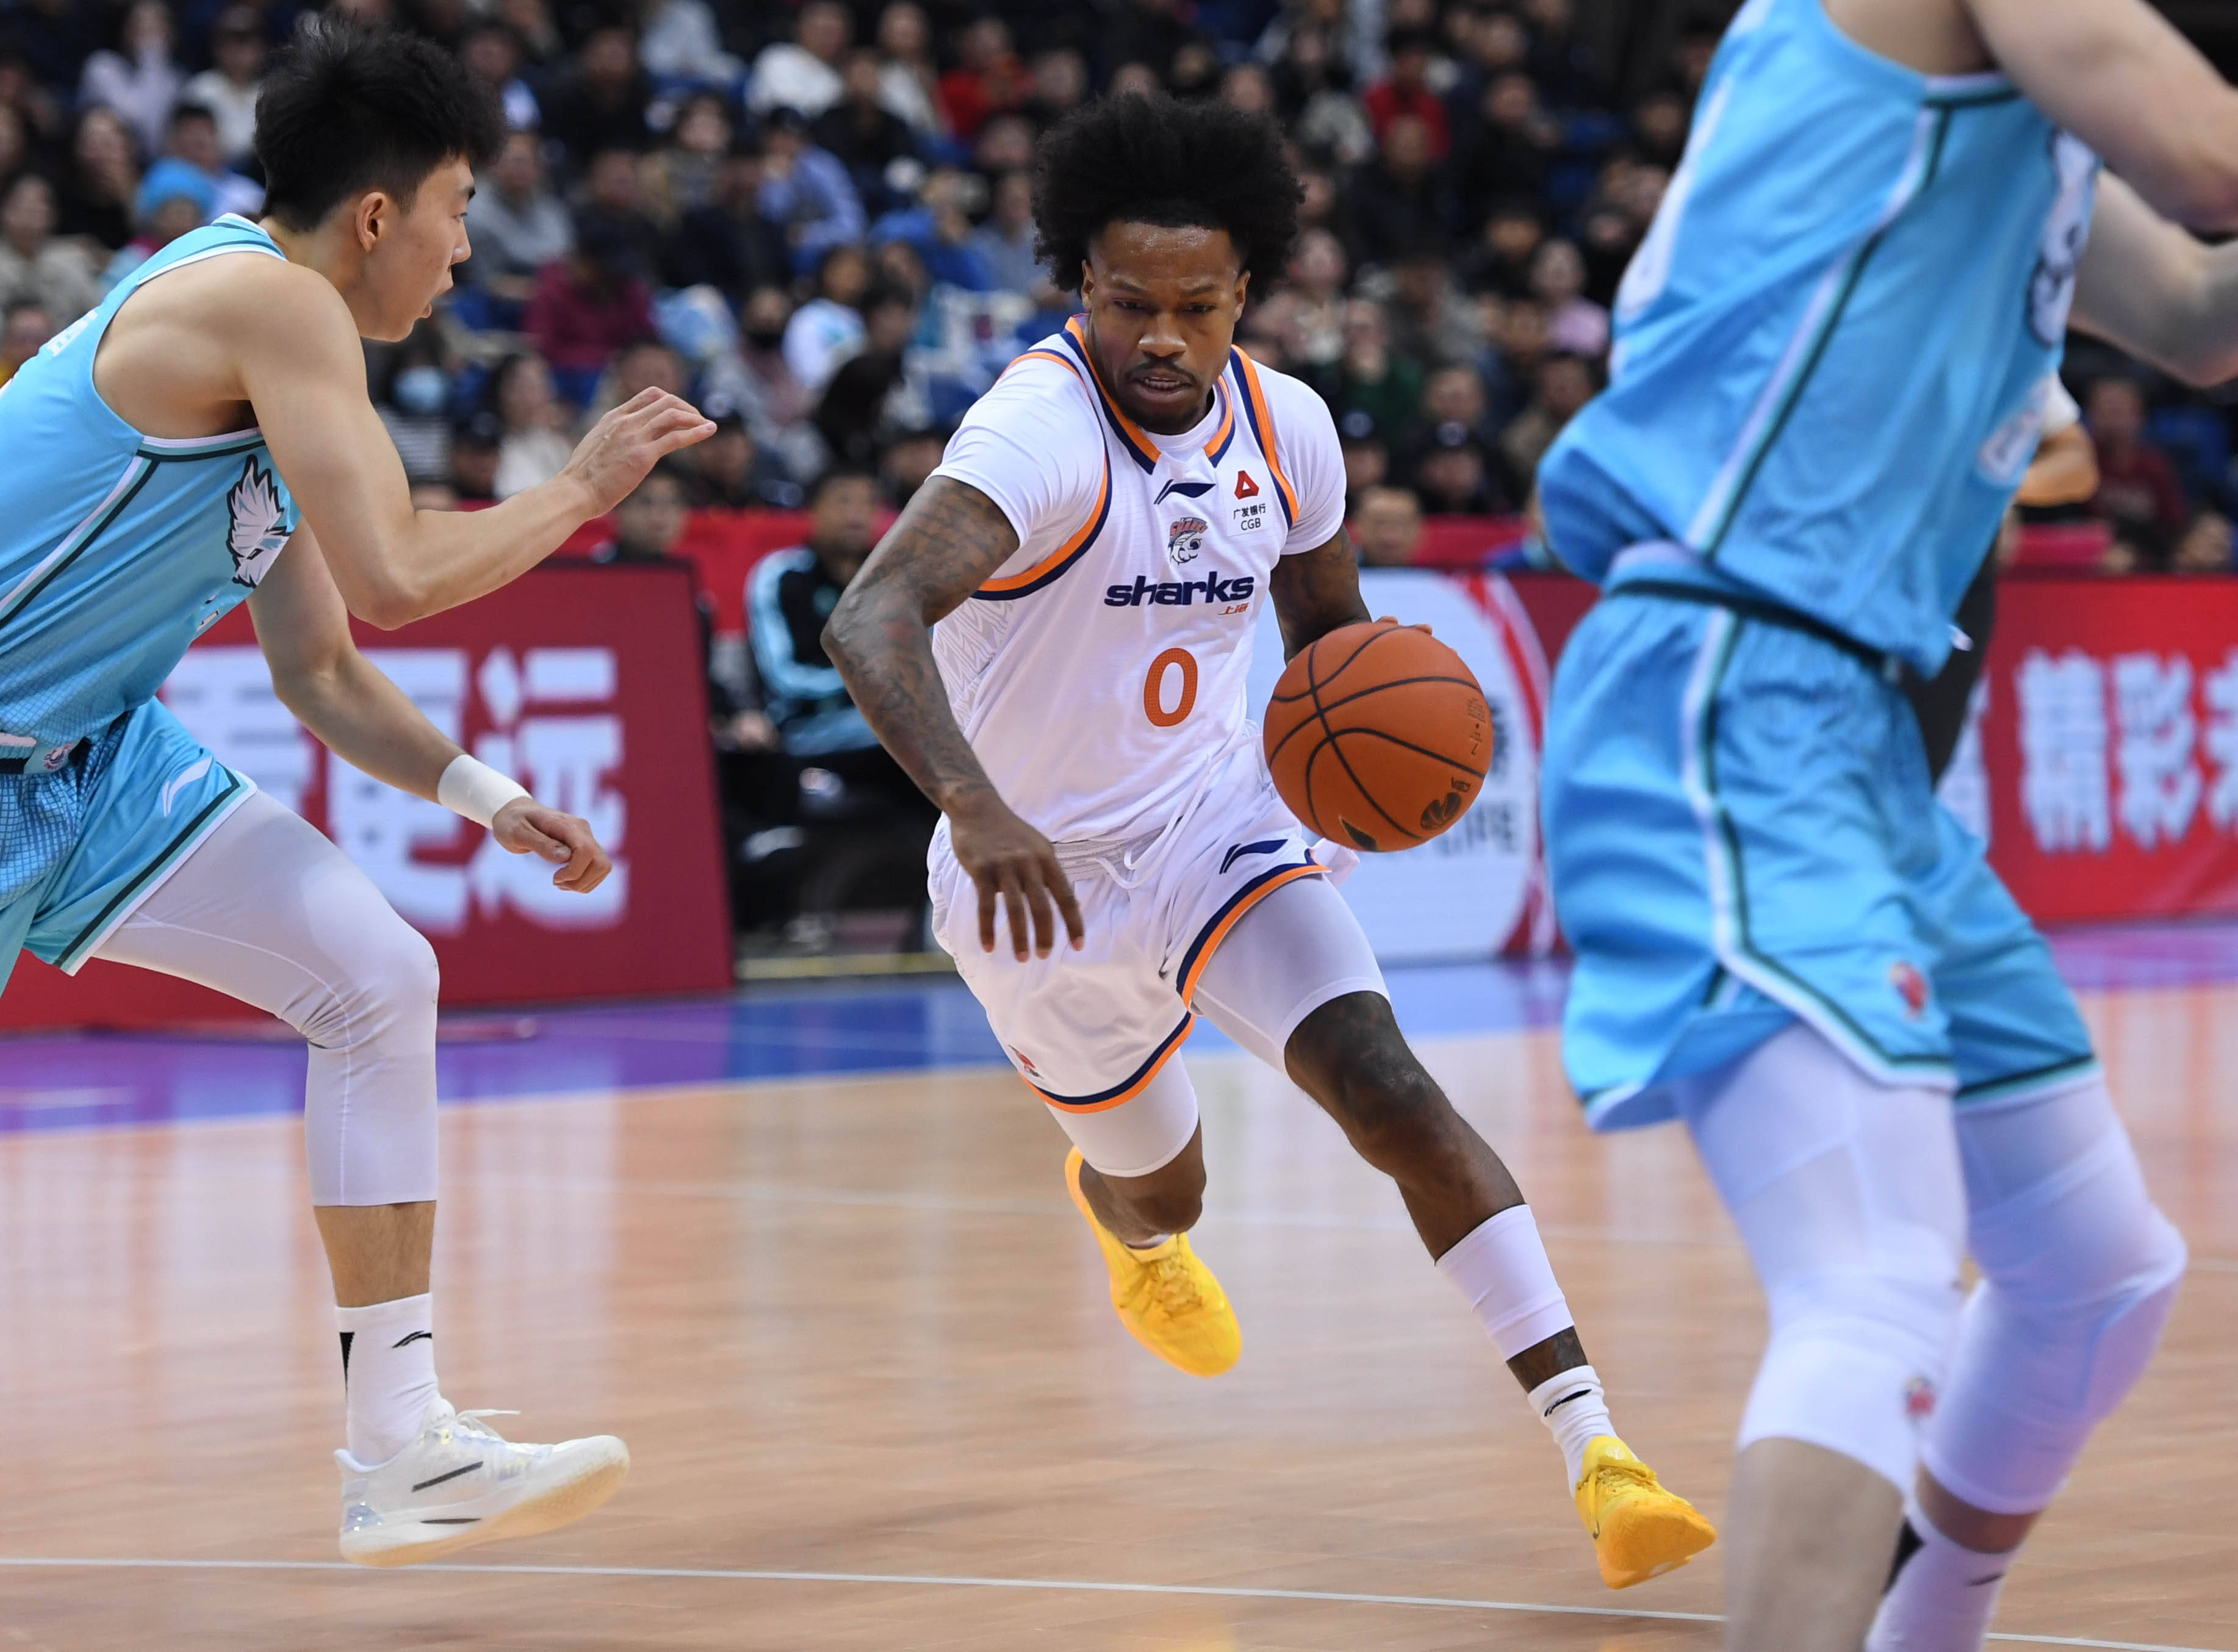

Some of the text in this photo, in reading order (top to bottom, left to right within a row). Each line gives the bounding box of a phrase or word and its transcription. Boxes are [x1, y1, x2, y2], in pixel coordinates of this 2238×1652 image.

[1233, 503, 1266, 520] 广发银行
[1240, 517, 1261, 531] CGB
[1104, 572, 1254, 607] sharks
[1143, 647, 1198, 727] 0
